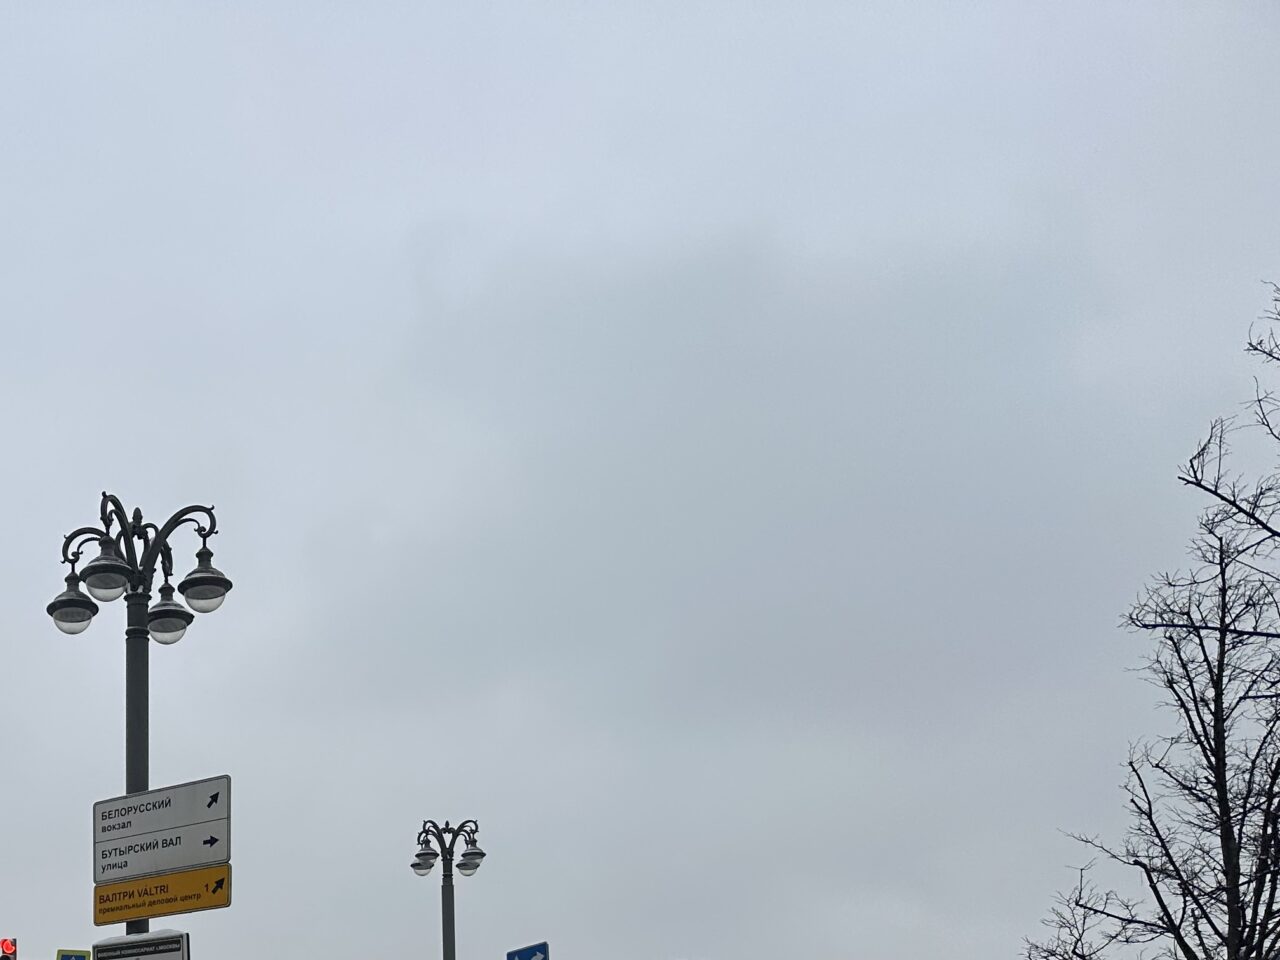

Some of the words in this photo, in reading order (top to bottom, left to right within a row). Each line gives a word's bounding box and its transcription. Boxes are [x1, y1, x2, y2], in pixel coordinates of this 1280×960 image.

[101, 797, 171, 820] БЕЛОРУССКИЙ
[101, 821, 132, 832] вокзал
[101, 840, 159, 859] БУТЫРСКИЙ
[161, 836, 182, 849] ВАЛ
[101, 860, 128, 873] улица
[204, 883, 209, 892] 1
[99, 892, 135, 904] ВАЛТРИ
[99, 901, 146, 915] премиальный
[147, 896, 178, 907] деловой
[179, 893, 201, 903] центр
